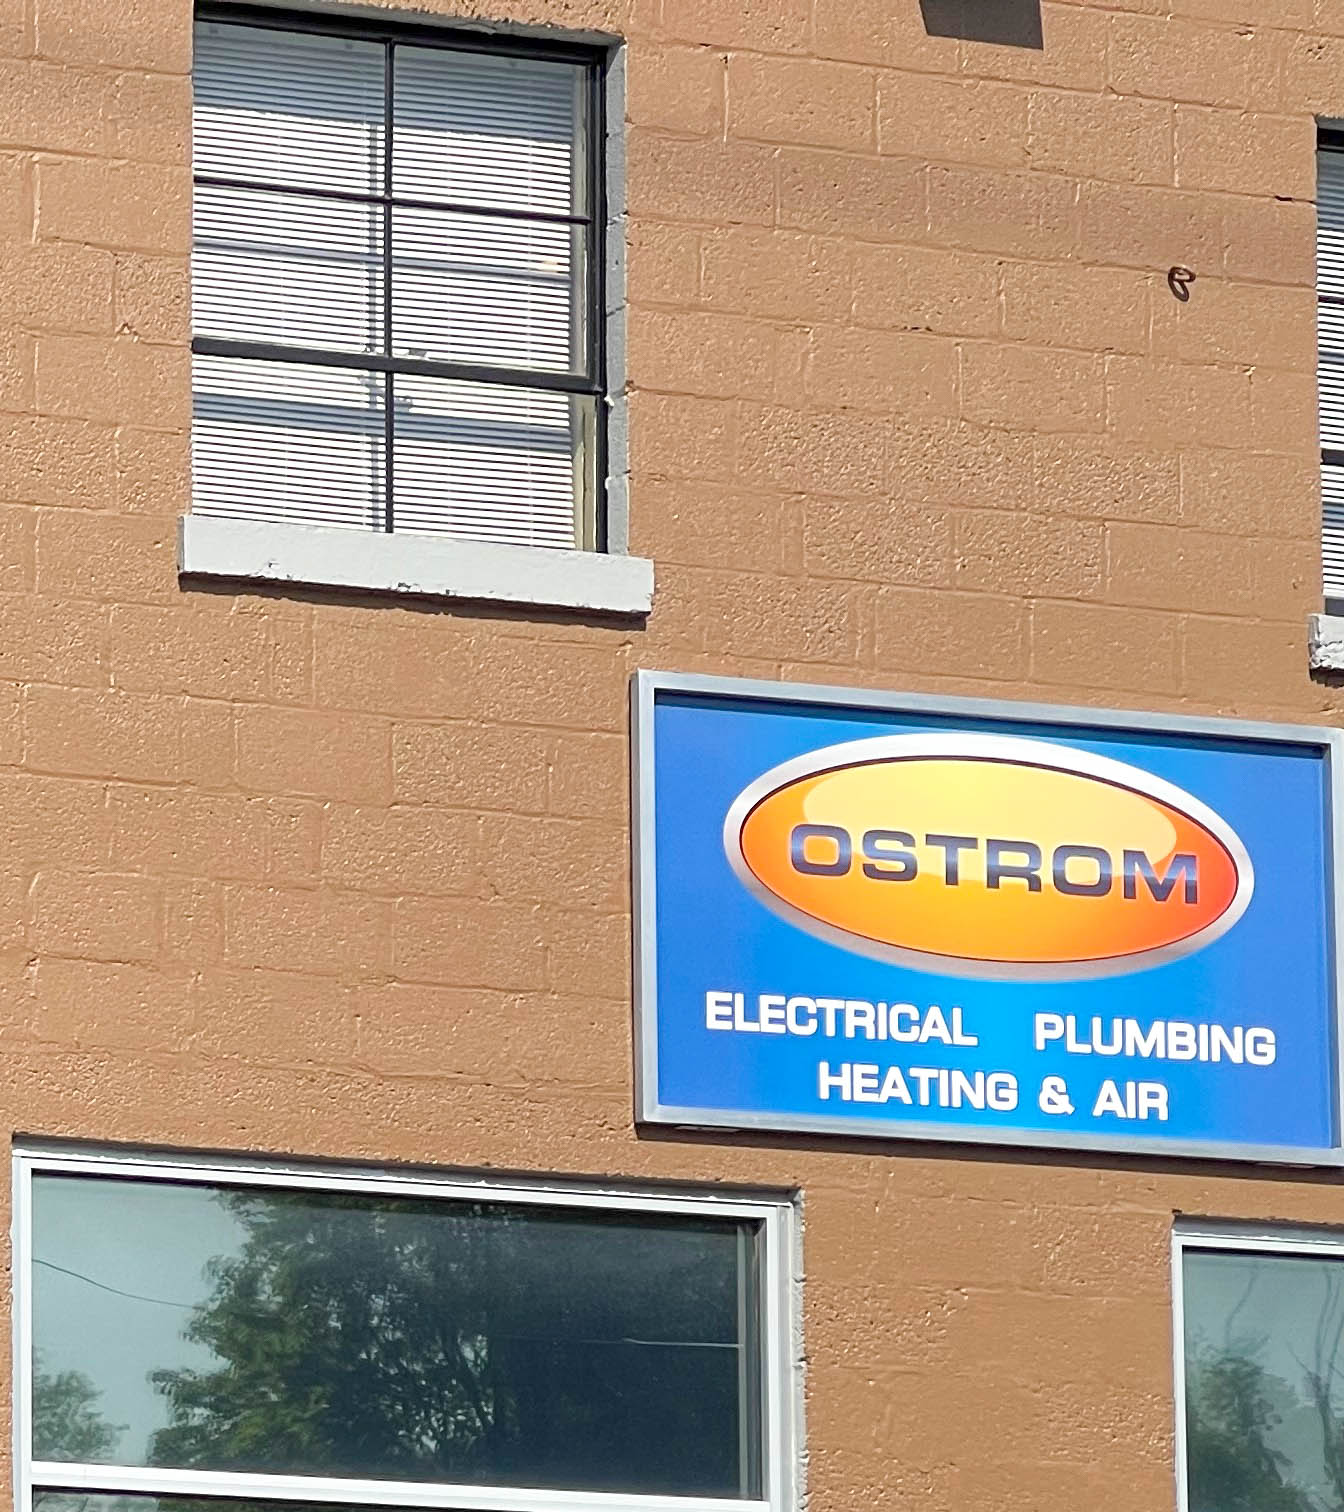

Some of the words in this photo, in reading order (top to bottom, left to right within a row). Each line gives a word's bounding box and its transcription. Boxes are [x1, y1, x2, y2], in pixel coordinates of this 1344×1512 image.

[790, 823, 1198, 905] OSTROM
[705, 991, 978, 1047] ELECTRICAL
[1034, 1012, 1277, 1066] PLUMBING
[818, 1061, 1018, 1112] HEATING
[1038, 1075, 1075, 1115] &
[1092, 1080, 1169, 1121] AIR
